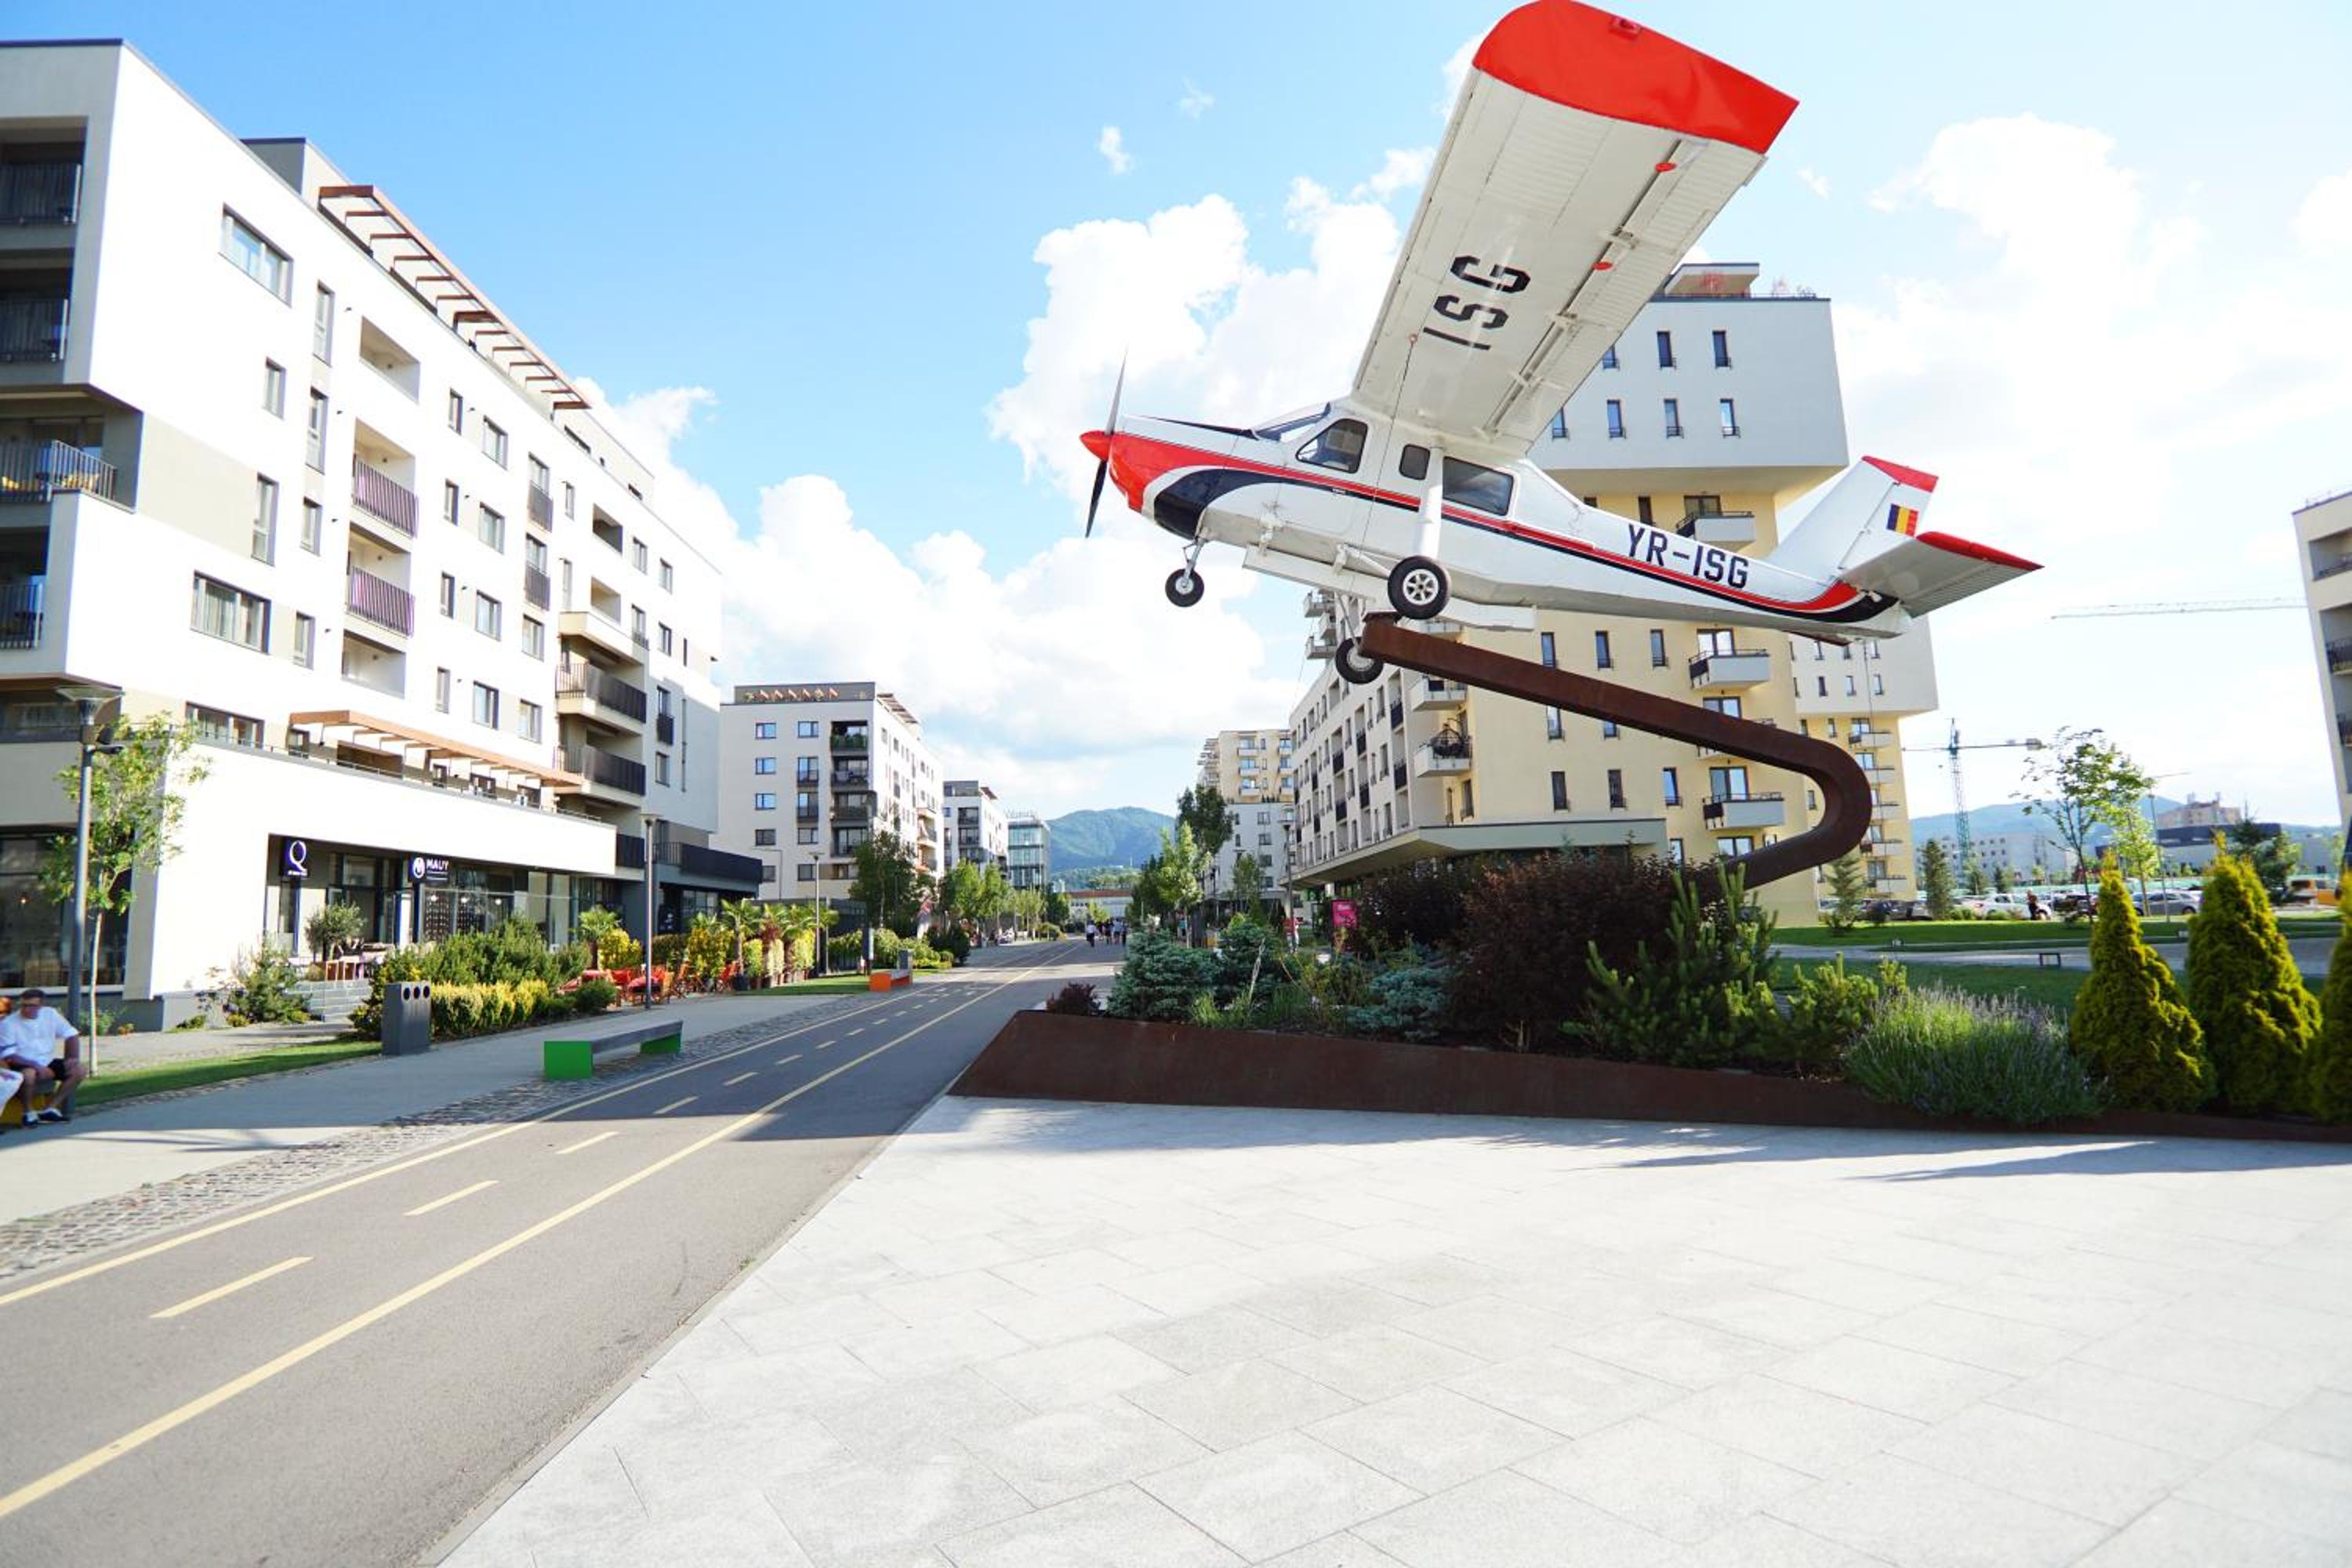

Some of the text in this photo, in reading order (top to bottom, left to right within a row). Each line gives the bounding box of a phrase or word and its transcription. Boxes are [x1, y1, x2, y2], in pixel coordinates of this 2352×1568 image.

[1423, 256, 1531, 350] ISG
[1628, 523, 1749, 589] YR-ISG
[289, 840, 307, 872] Q
